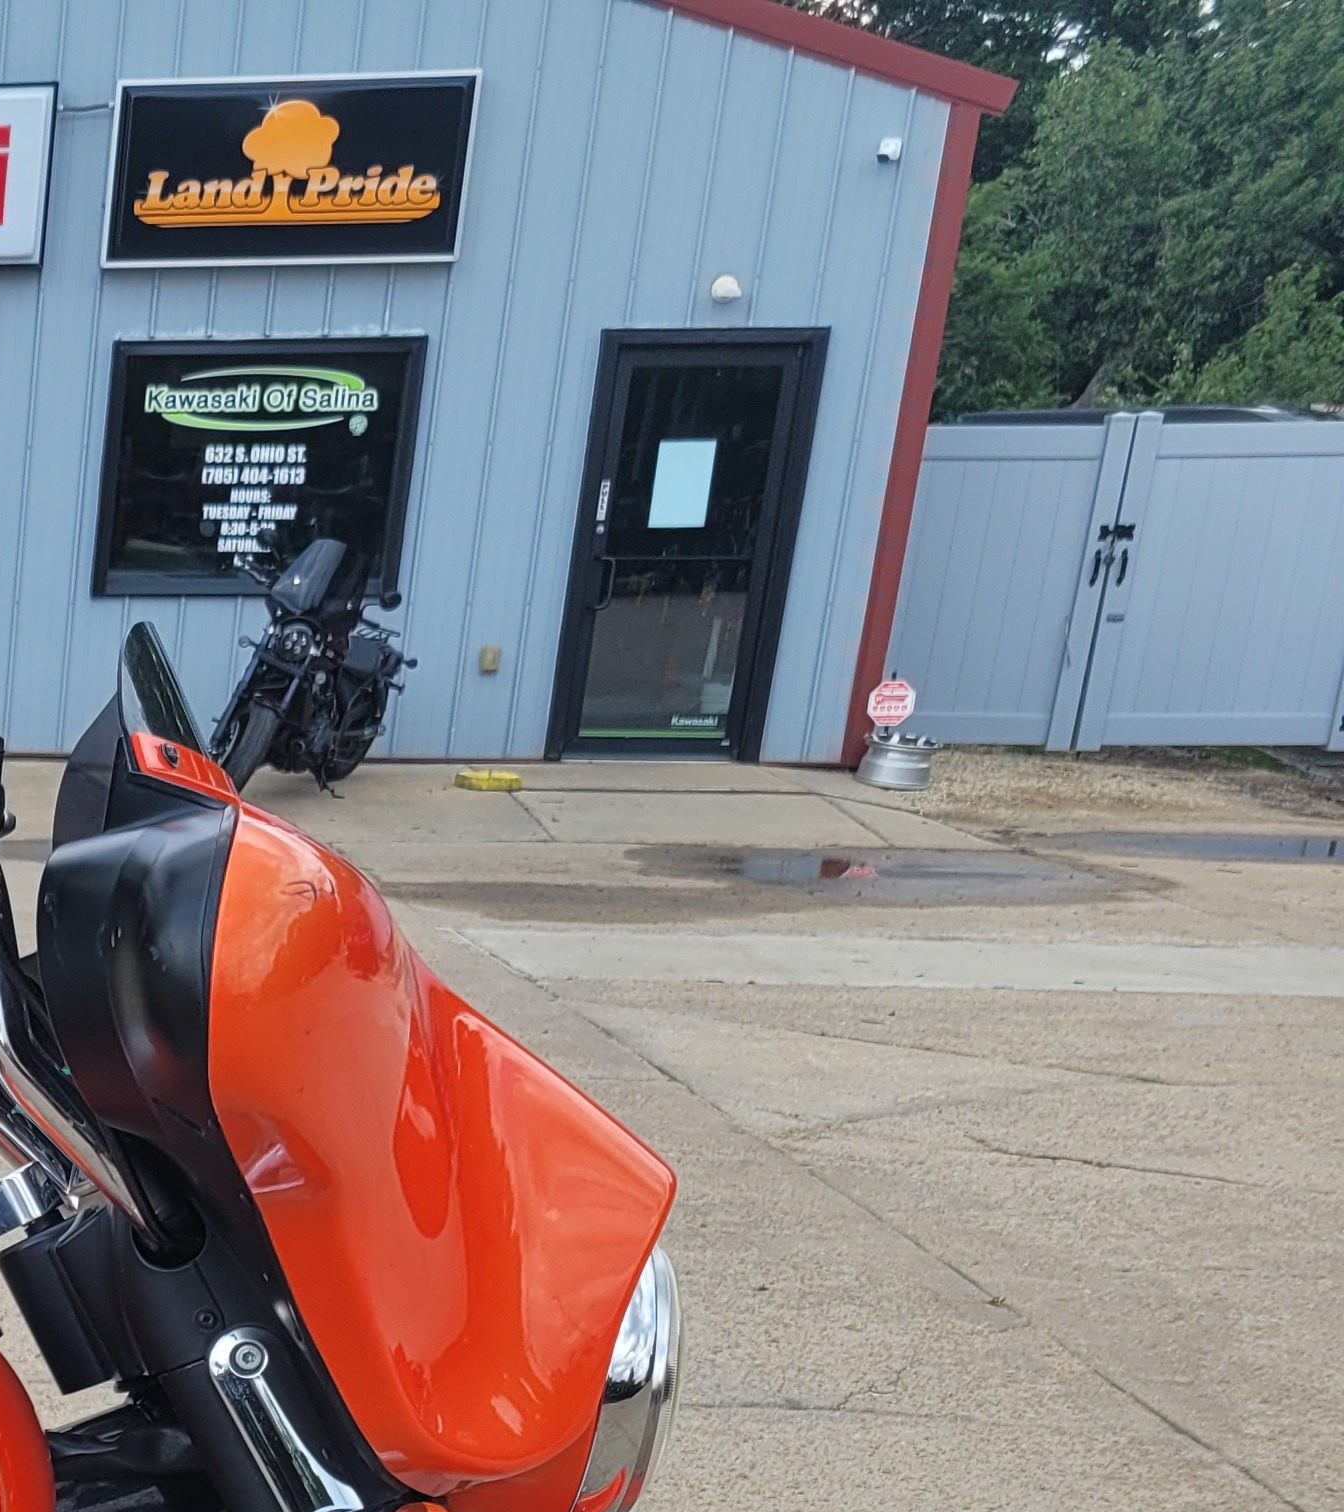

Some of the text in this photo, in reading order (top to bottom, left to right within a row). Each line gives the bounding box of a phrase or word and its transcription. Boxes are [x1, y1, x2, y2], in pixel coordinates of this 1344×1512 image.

[144, 163, 440, 211] Land Pride
[145, 383, 379, 414] Kawasaki Of Salina
[204, 443, 308, 464] 632 S. OHIO ST.
[229, 487, 273, 504] HOURS:
[202, 503, 251, 521] TUESDAY
[257, 503, 299, 521] FRIDAY
[217, 537, 272, 553] SATURD
